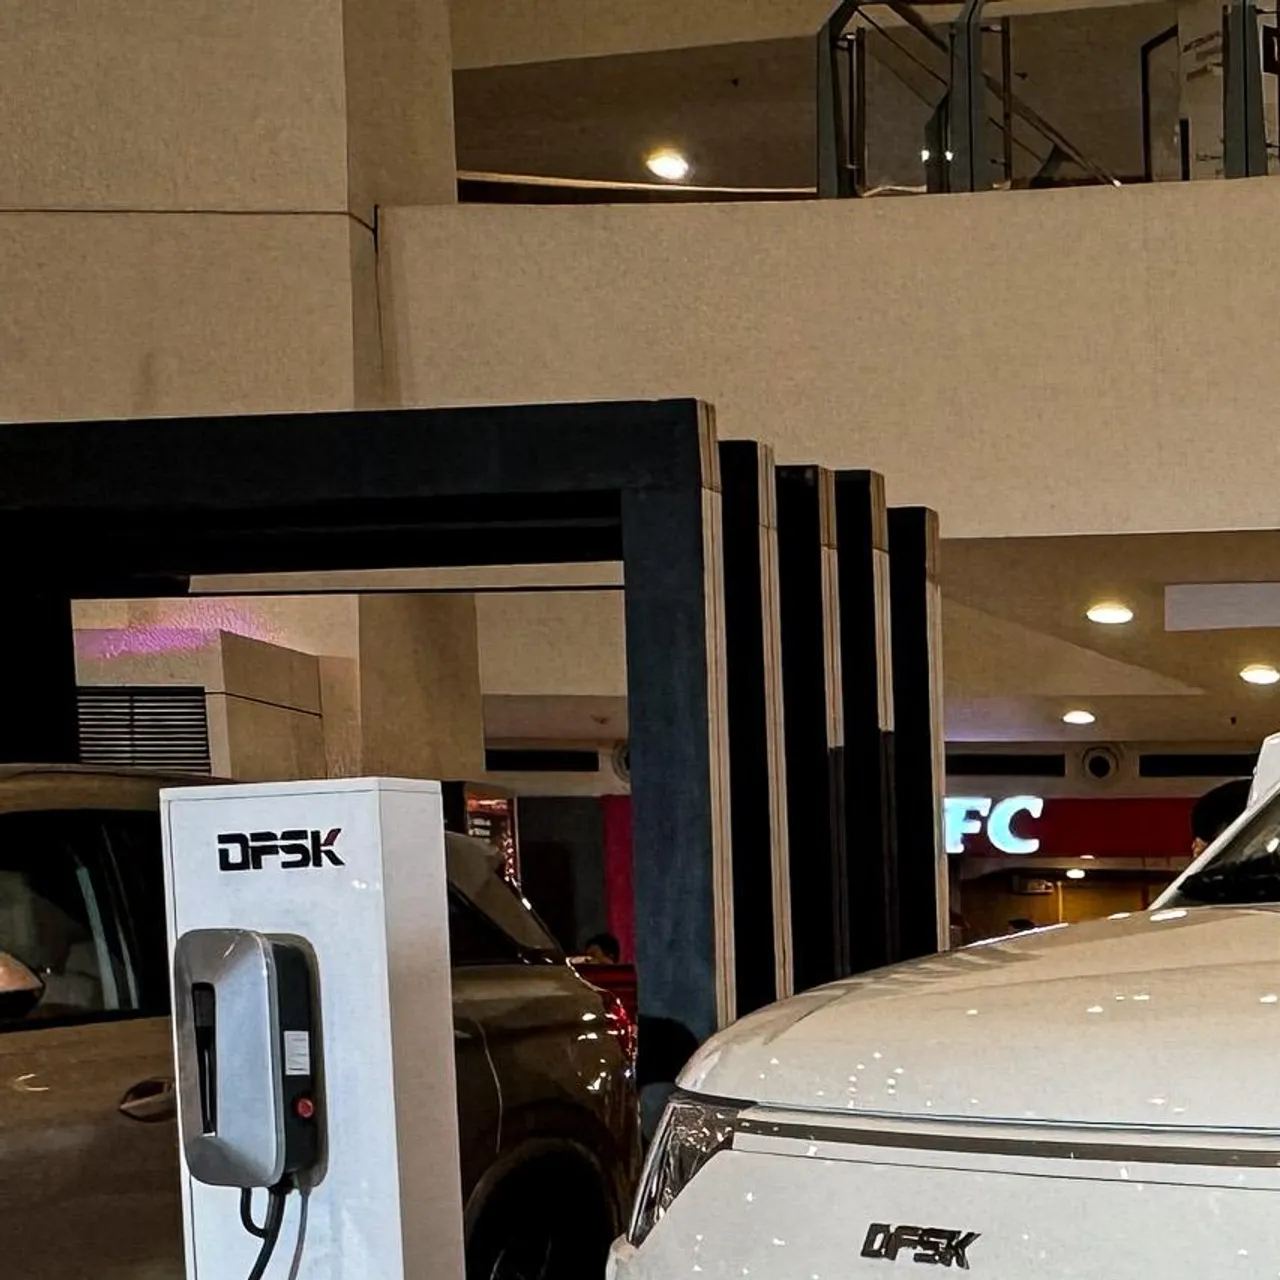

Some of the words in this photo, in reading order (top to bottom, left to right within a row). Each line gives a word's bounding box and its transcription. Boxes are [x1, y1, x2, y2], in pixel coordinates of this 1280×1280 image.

[944, 795, 1043, 854] FC
[217, 828, 345, 871] DFSK
[860, 1222, 982, 1270] DFSK
